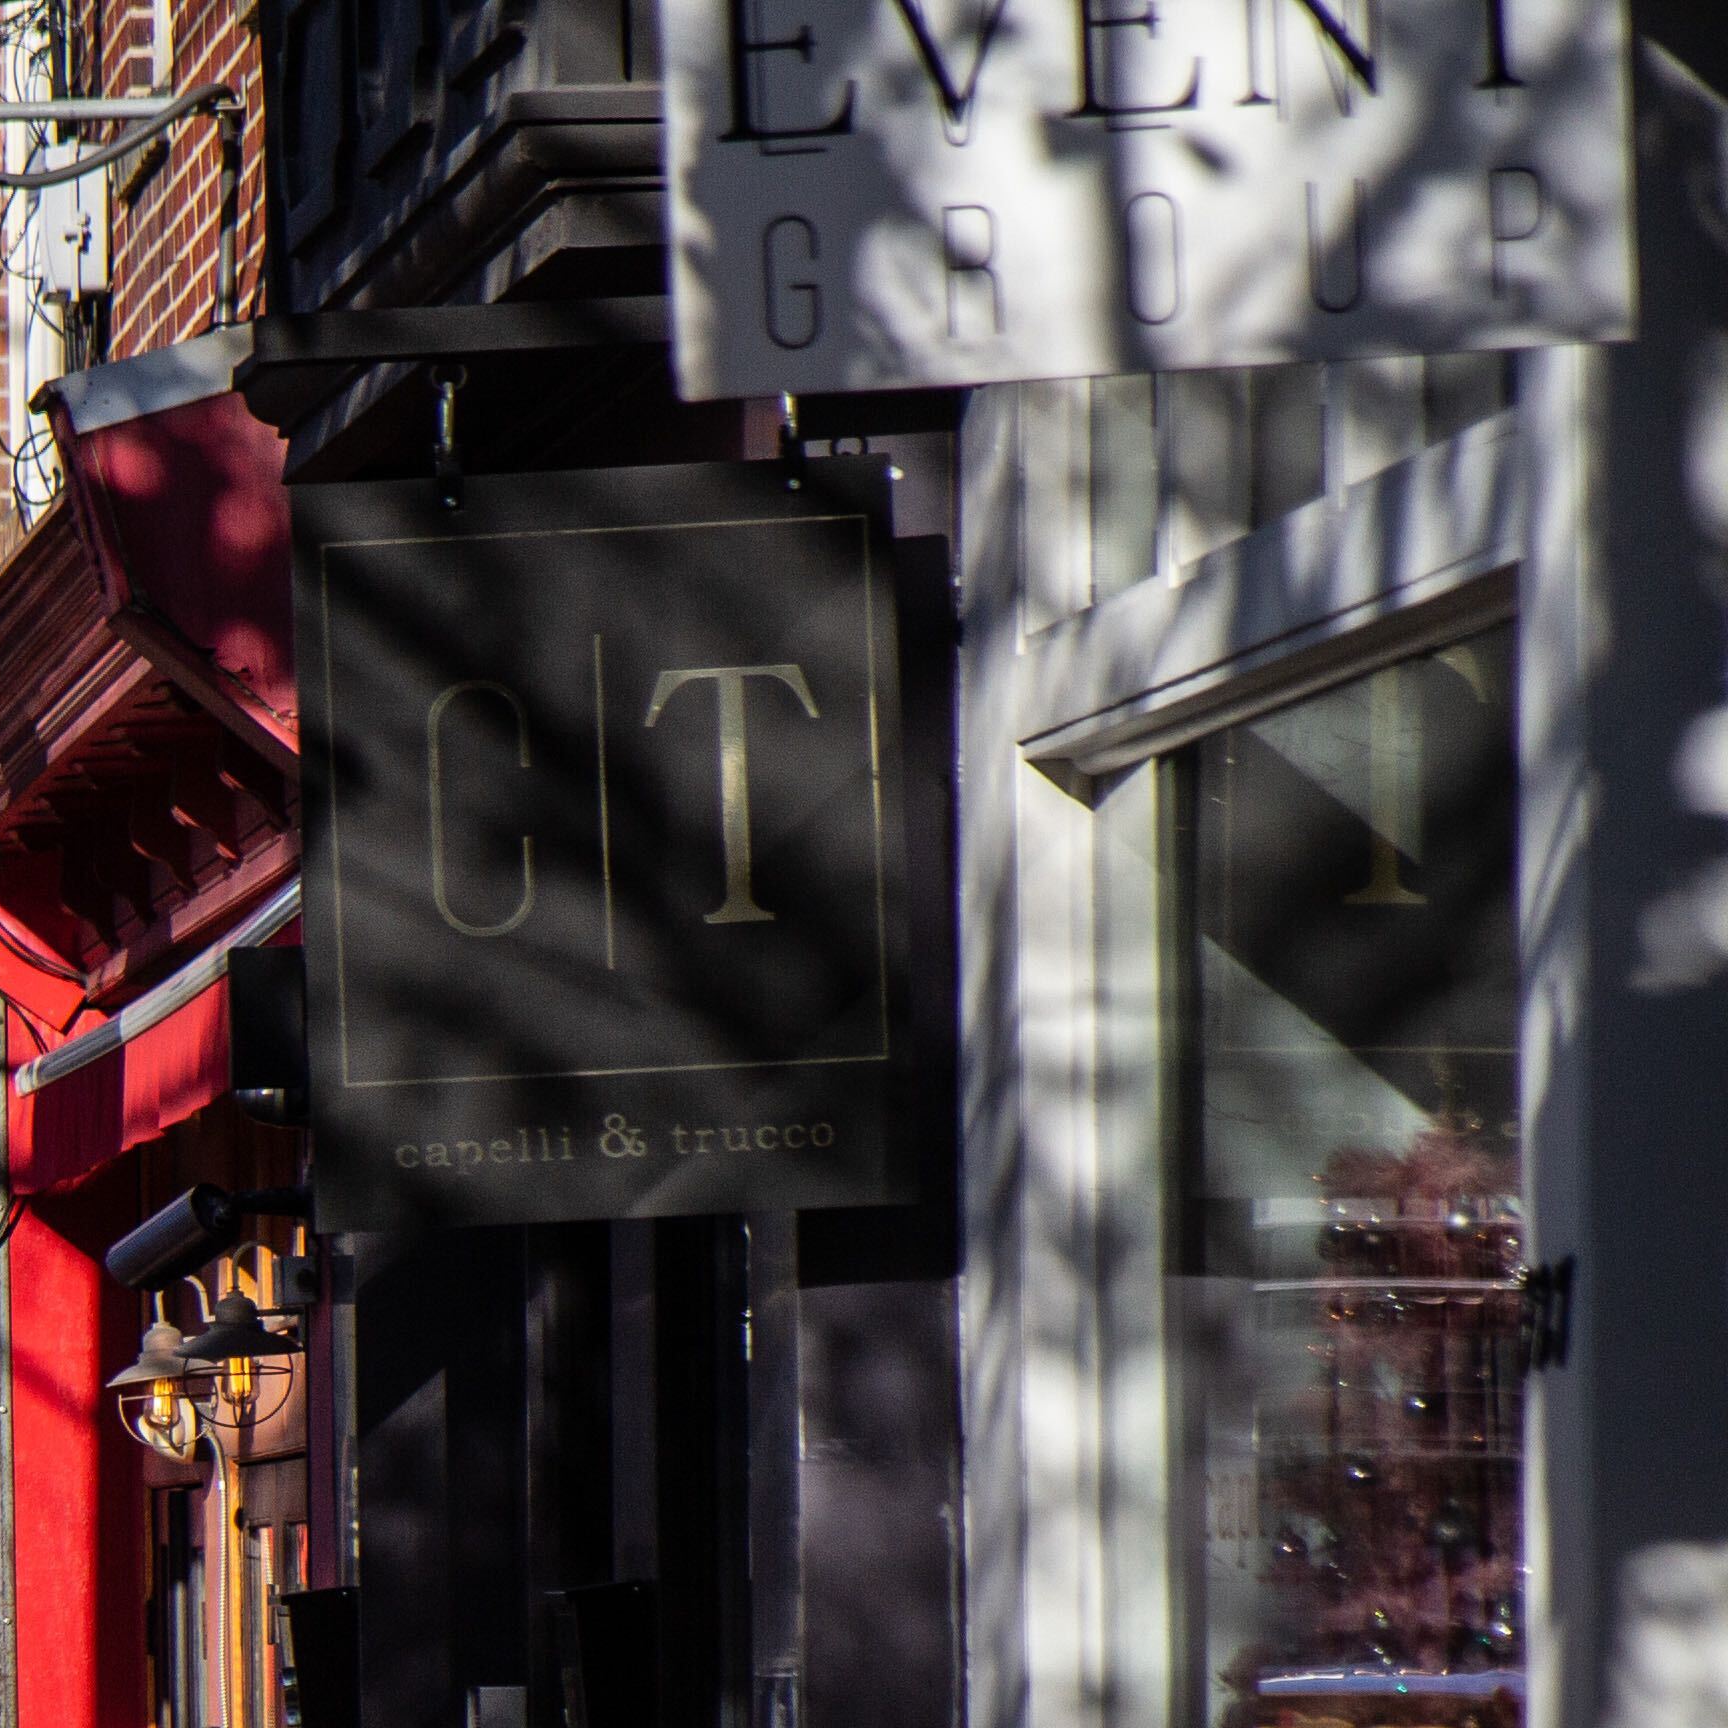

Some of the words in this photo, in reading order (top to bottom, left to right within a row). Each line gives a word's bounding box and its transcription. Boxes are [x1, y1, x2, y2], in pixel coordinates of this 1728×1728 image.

[761, 164, 1542, 350] GROUP
[395, 1127, 575, 1175] capelli
[600, 1113, 645, 1158] &
[672, 1122, 835, 1155] trucco
